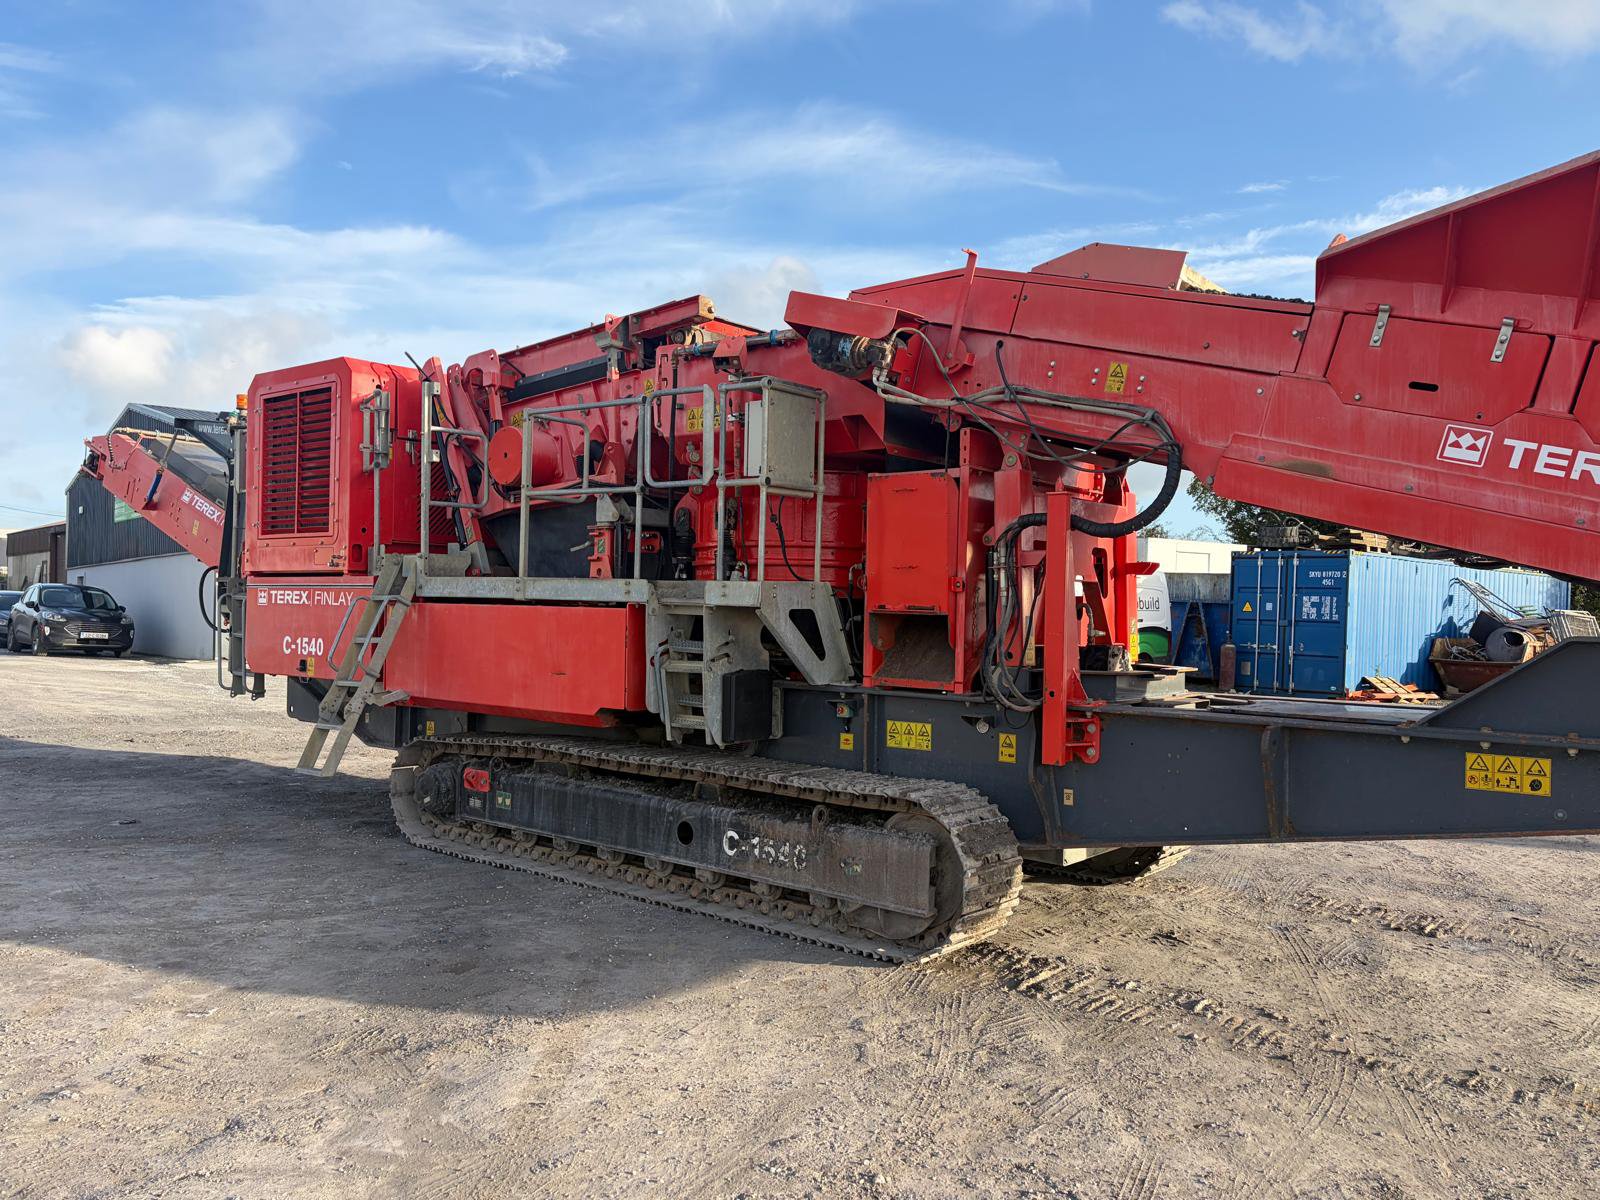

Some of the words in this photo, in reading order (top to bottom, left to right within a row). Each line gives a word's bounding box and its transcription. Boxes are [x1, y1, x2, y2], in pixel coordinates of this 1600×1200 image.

[191, 494, 221, 522] TEREX
[269, 590, 309, 605] TEREX
[314, 590, 353, 606] FINLAY
[1136, 595, 1160, 610] build
[282, 635, 324, 656] C-1540
